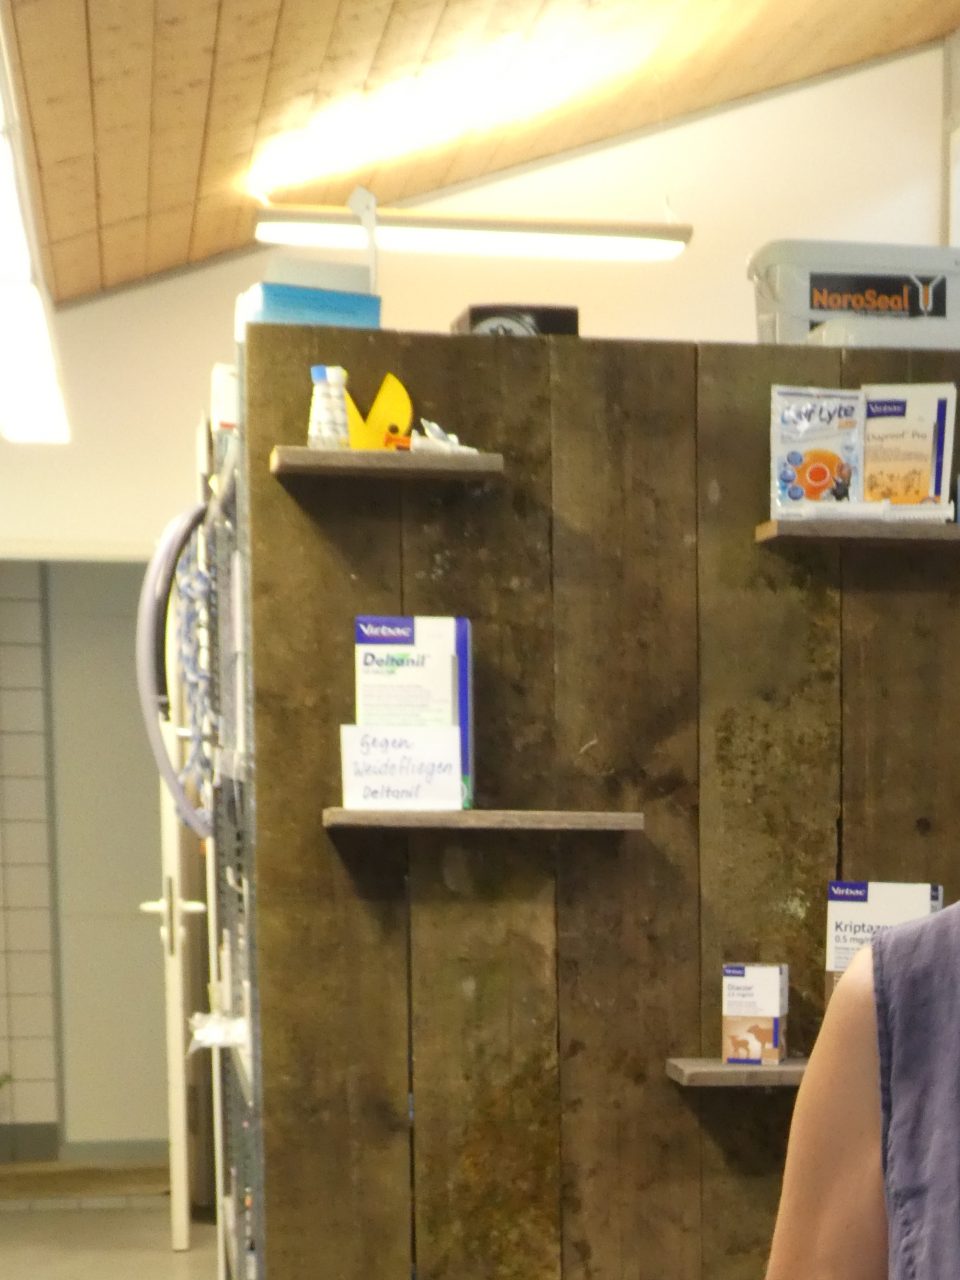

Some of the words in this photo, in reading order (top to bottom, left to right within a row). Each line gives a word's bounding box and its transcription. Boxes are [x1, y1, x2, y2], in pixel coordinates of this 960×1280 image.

[812, 286, 909, 310] NoroSeal
[363, 653, 425, 668] Deltanil
[360, 733, 412, 755] Gegen
